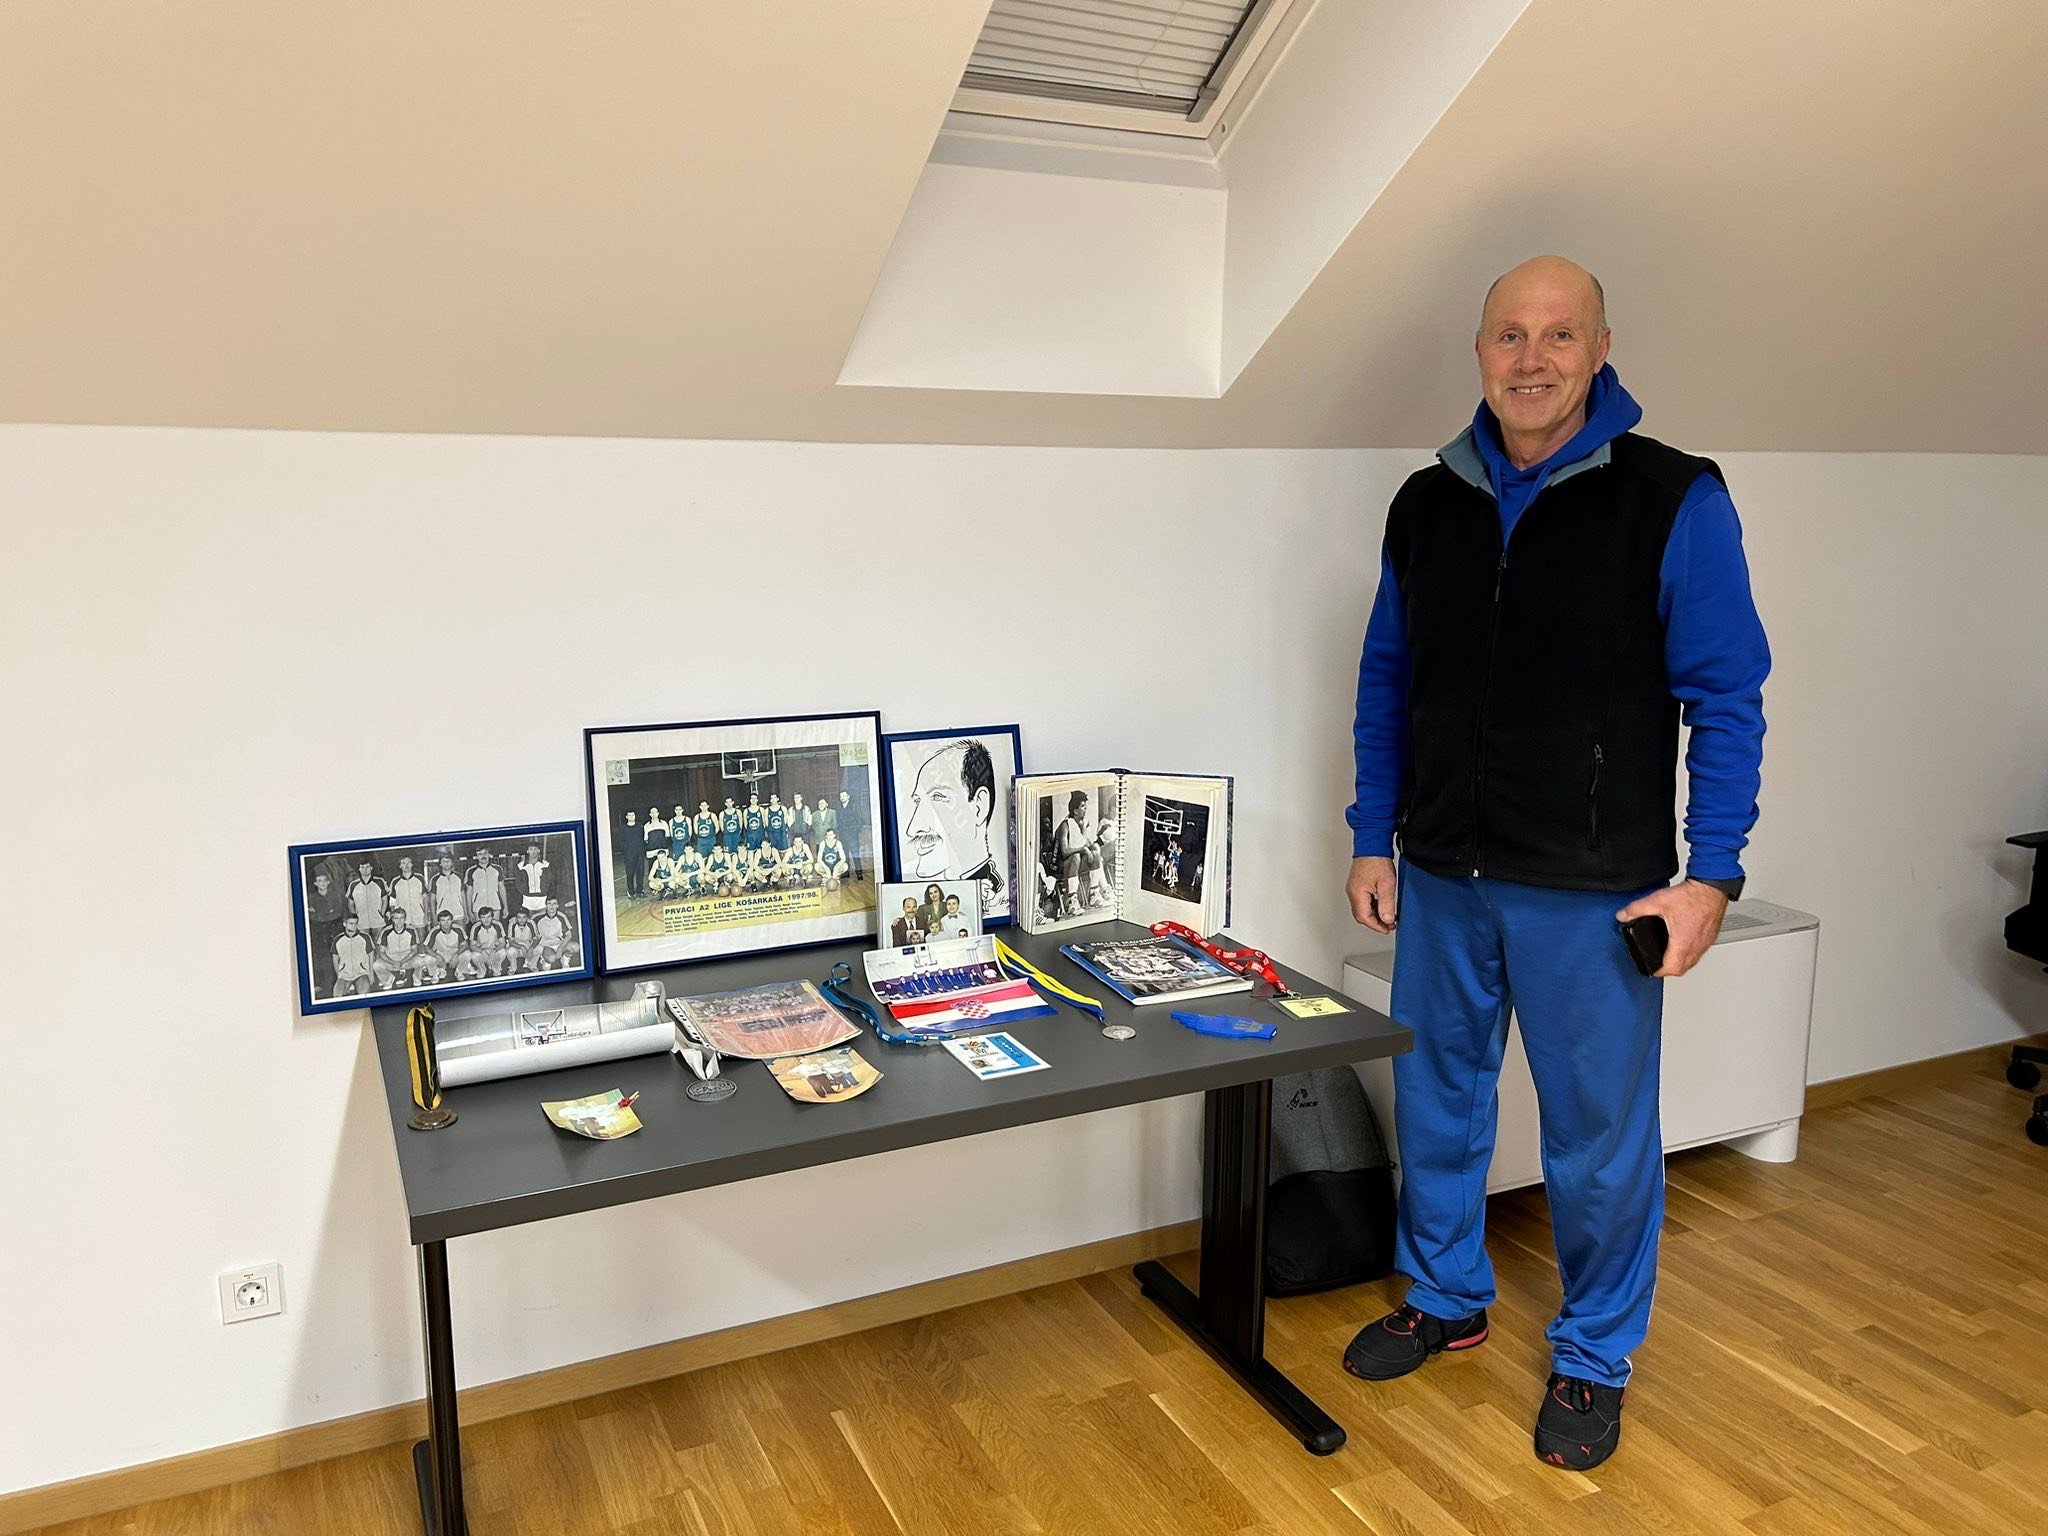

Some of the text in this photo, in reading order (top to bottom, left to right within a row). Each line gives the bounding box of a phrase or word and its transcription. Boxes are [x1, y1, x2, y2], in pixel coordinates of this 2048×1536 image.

[665, 906, 695, 915] PRVACI
[714, 901, 732, 909] LIGE
[736, 895, 783, 906] KOŠARKAŠA
[787, 891, 819, 900] 1997/98.
